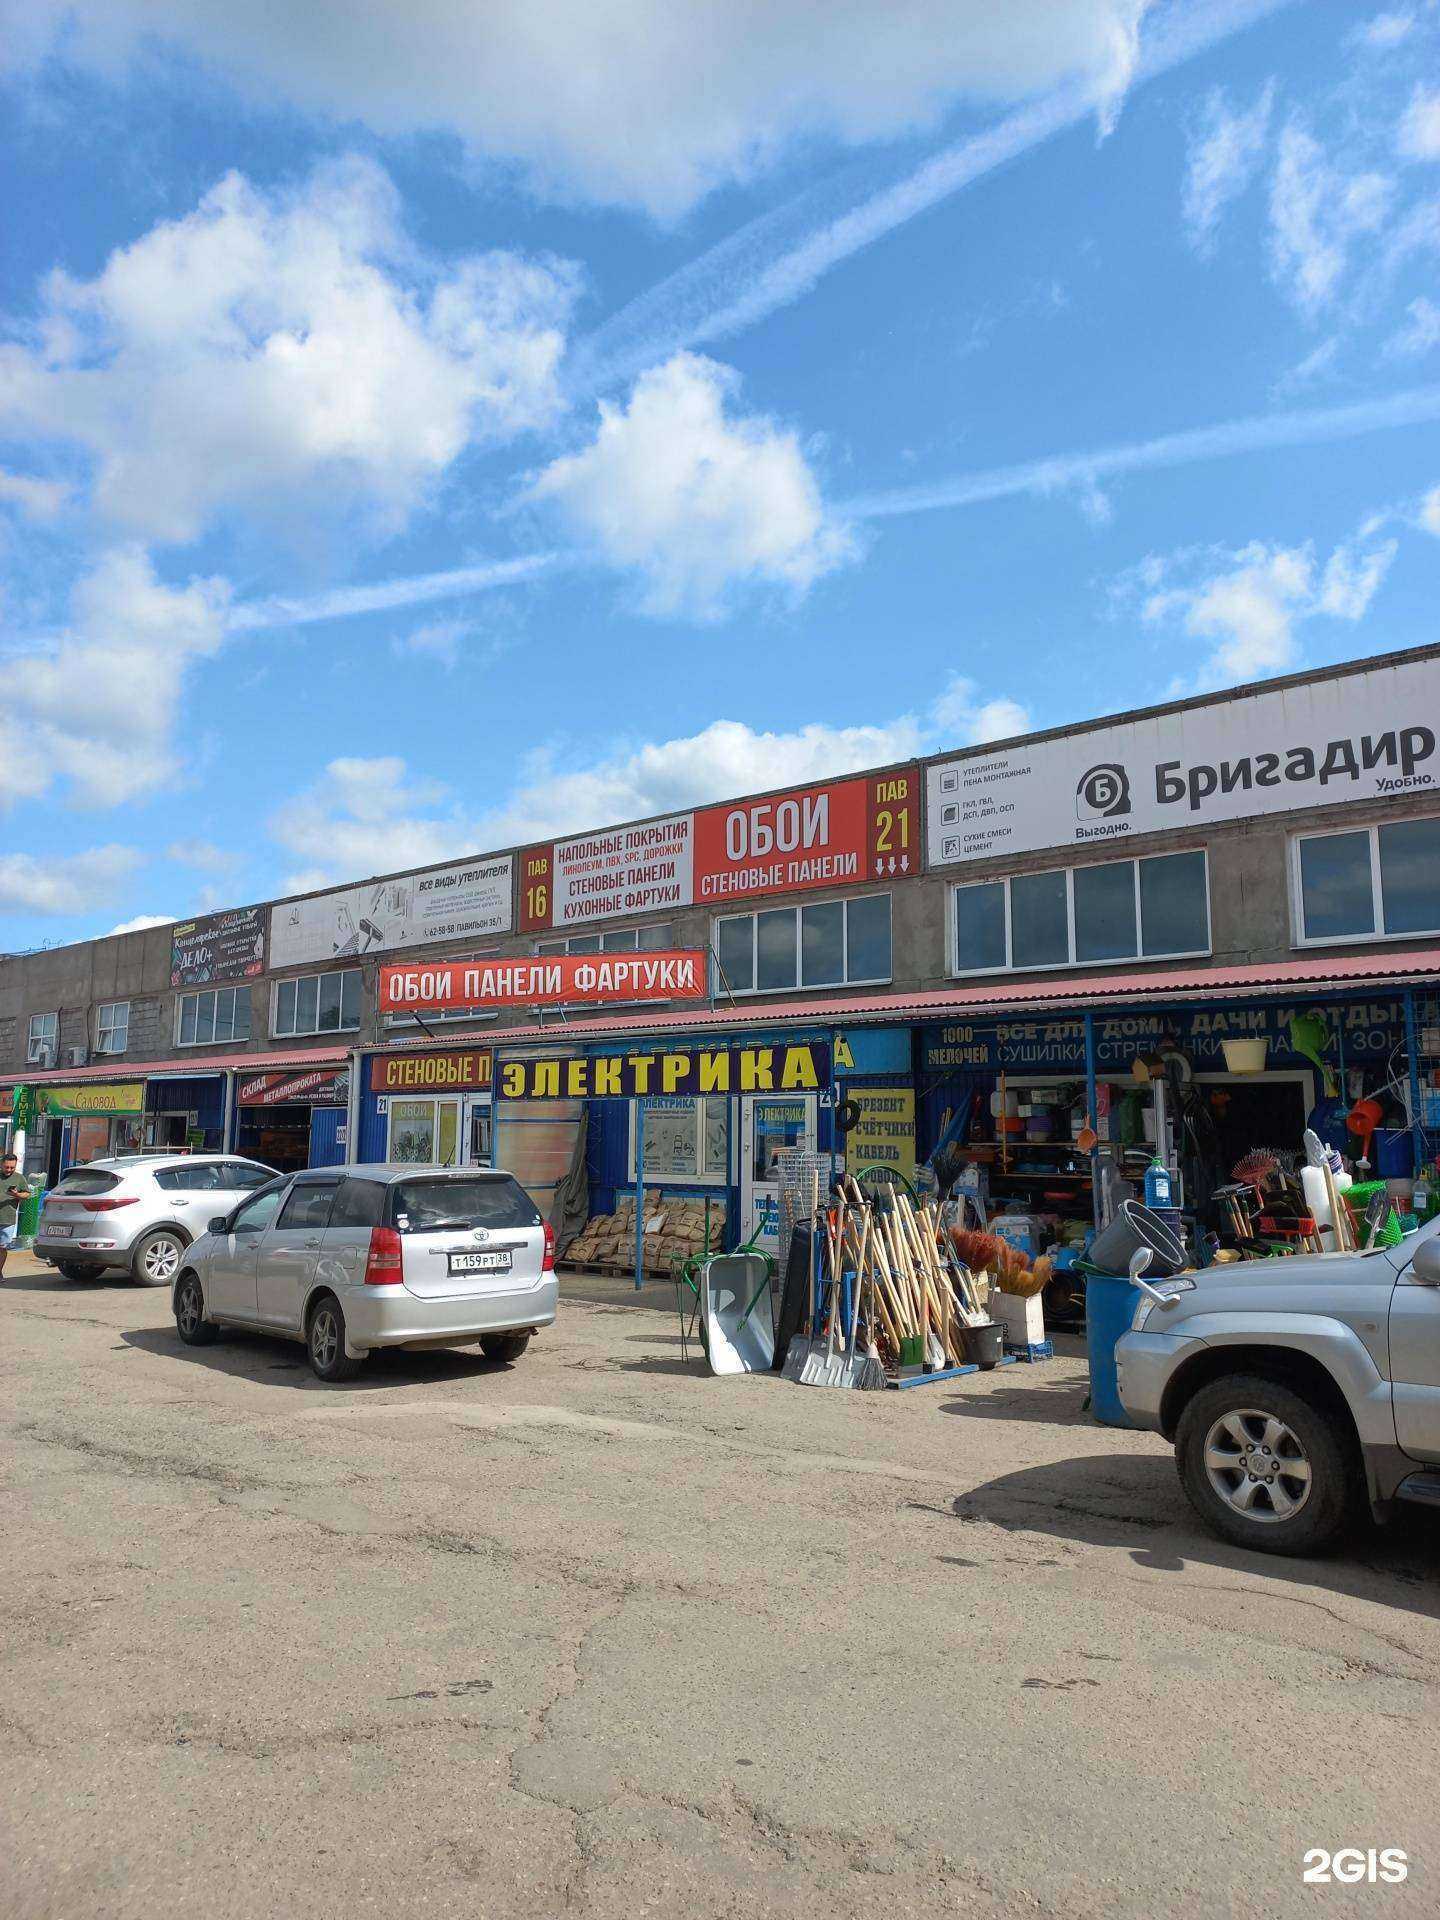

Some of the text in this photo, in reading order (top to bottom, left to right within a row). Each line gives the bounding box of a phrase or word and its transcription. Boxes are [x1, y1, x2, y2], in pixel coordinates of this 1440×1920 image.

[963, 761, 1009, 776] УТЕПЛИТЕЛИ
[963, 767, 1031, 788] ПЕНА МОНТАЖНАЯ
[1155, 725, 1436, 811] Бригадир
[876, 780, 908, 804] ПАВ
[1376, 774, 1436, 793] Удобно.
[999, 803, 1015, 813] ОСП
[726, 793, 830, 862] ОБОИ
[876, 807, 909, 852] 21
[963, 828, 1012, 842] СУХИЕ СМЕСИ
[1075, 821, 1132, 840] Выгодно.
[558, 820, 688, 864] НАПОЛЬНЫЕ ПОКРЫТИЯ
[963, 842, 993, 853] ЦЕМЕНТ
[528, 859, 548, 877] ПАВ
[562, 859, 605, 876] ЛИНОЛЕУМ,
[643, 844, 684, 861] ДОРОЖКИ
[569, 862, 675, 897] СТЕНОВЫЕ ПАНЕЛИ
[701, 852, 858, 896] СТЕНОВЫЕ ПАНЕЛИ
[526, 885, 547, 919] 16
[563, 884, 681, 920] КУХОННЫЕ ФАРТУКИ
[456, 919, 488, 932] ПАВИЛЬОН
[389, 959, 694, 1001] ОБОИ ПАНЕЛИ ФАРТУКИ
[942, 1026, 973, 1043] 1000
[996, 1022, 1037, 1042] ВСЕ
[1044, 1020, 1086, 1042] ДЛ
[1191, 1010, 1267, 1035] ДАЧИ
[928, 1043, 989, 1065] МЕЛОЧЕЙ
[997, 1040, 1086, 1063] СУШИЛКИ
[1097, 1036, 1222, 1060] СТРЕНКИ
[386, 1056, 474, 1086] СТЕНОВЫЕ
[503, 1046, 819, 1097] ЭЛЕКТРИКА
[242, 1075, 267, 1099] СКЛАД
[643, 1097, 696, 1109] ЛЕКТРИКА
[855, 1144, 900, 1161] КАБЕЛЬ
